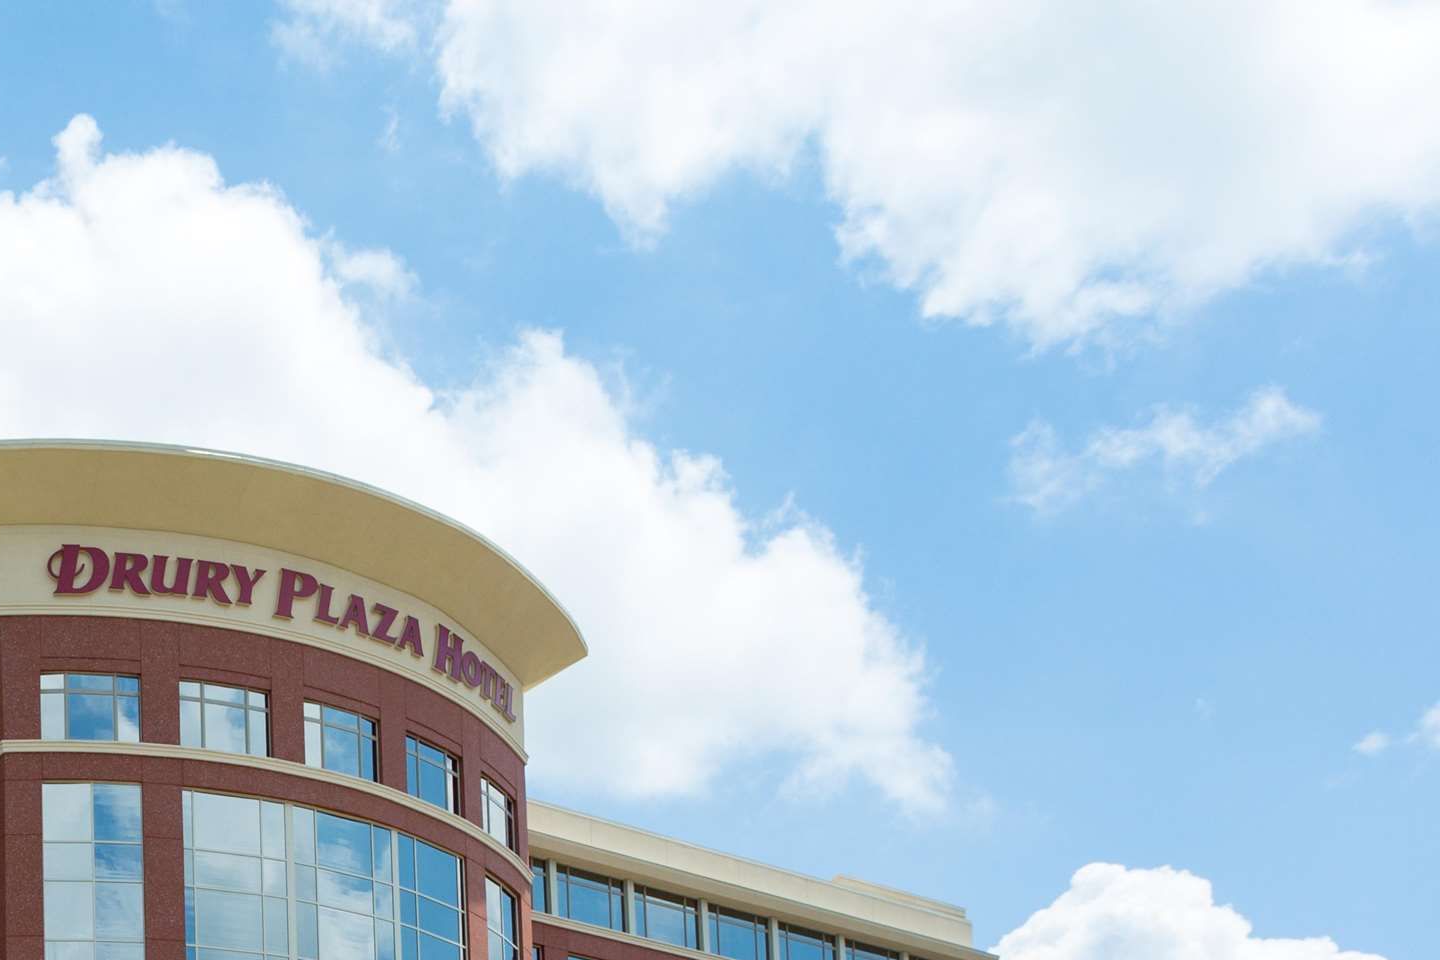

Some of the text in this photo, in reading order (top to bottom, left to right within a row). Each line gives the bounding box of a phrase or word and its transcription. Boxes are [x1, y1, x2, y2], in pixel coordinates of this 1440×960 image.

[47, 544, 517, 722] DRURY PLAZA HOTEL
